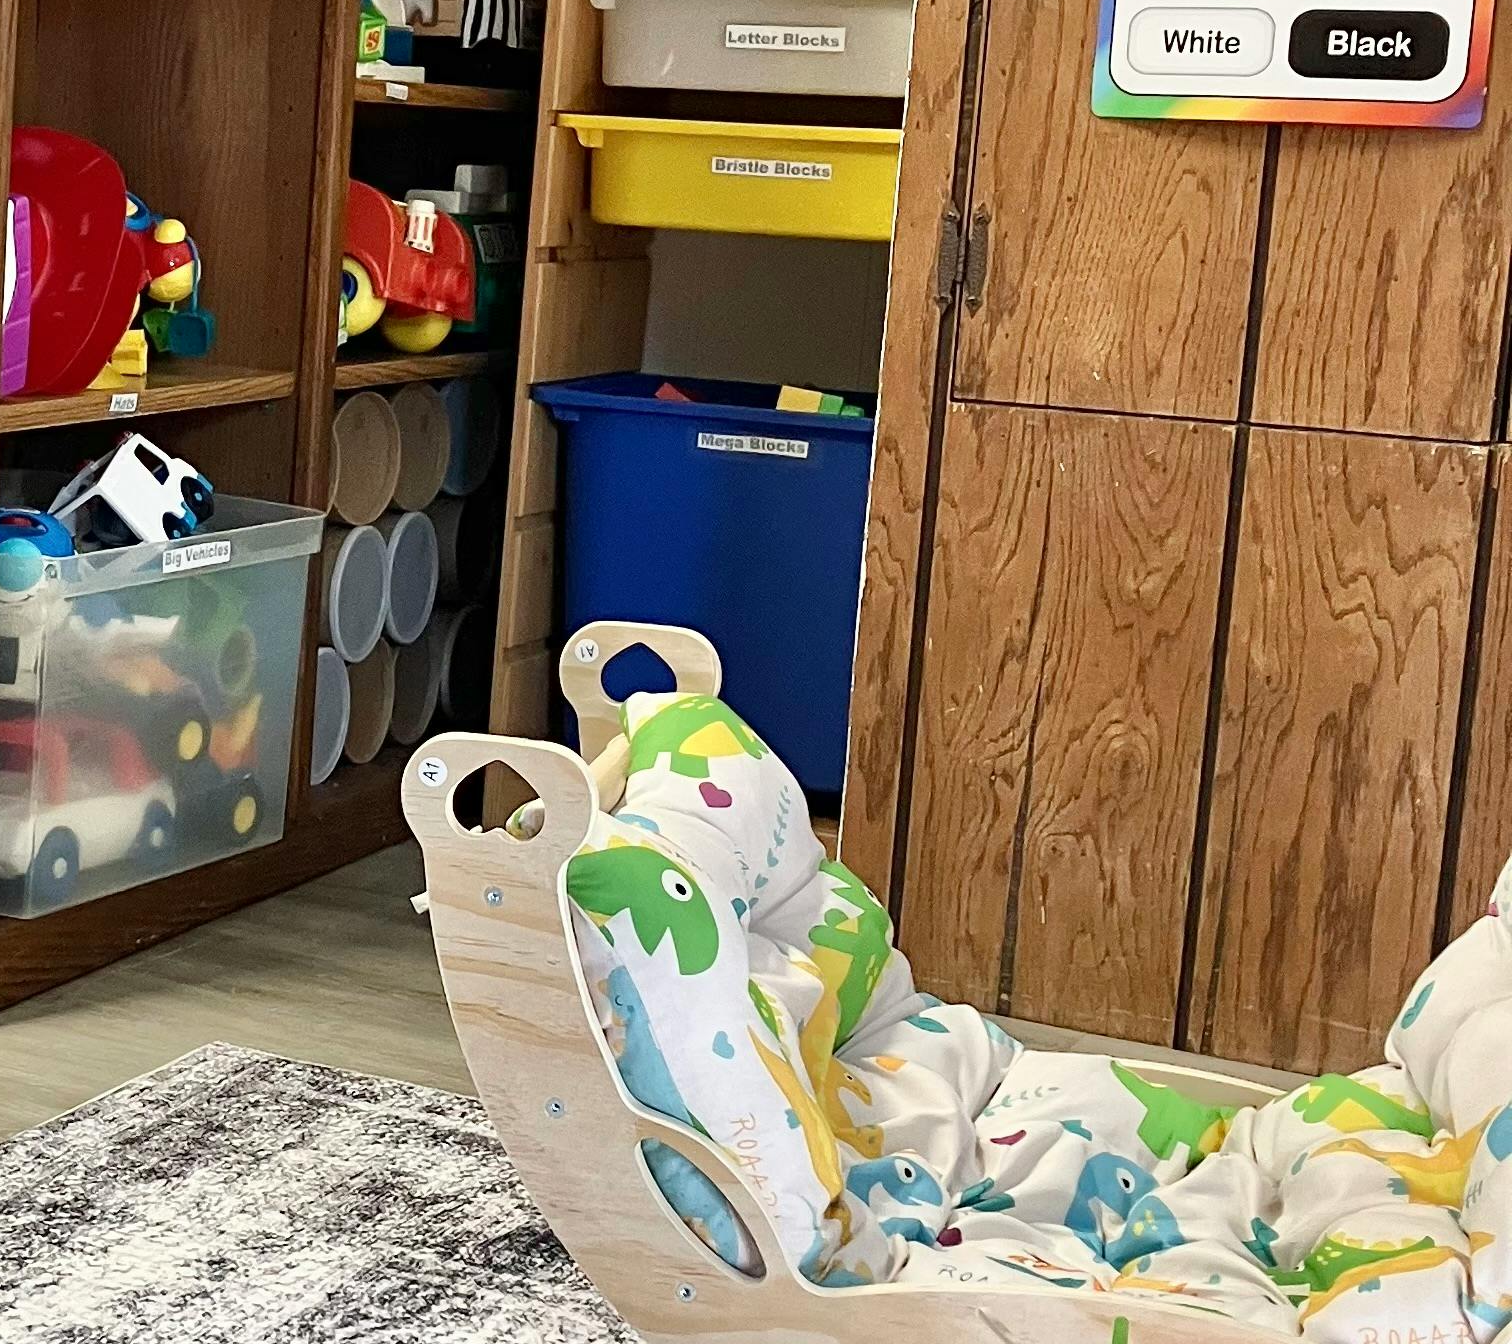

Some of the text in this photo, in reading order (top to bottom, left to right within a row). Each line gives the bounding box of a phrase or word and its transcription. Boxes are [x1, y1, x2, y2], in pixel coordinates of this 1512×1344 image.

[727, 31, 839, 47] Letter Blocks
[1163, 29, 1240, 54] White
[1327, 30, 1412, 57] Black
[715, 158, 830, 178] Bristle Blocks
[114, 395, 136, 408] Hats
[701, 434, 805, 454] Mega Blocks
[164, 543, 229, 567] Big Vehicles
[580, 645, 595, 658] A1
[423, 762, 440, 782] A1
